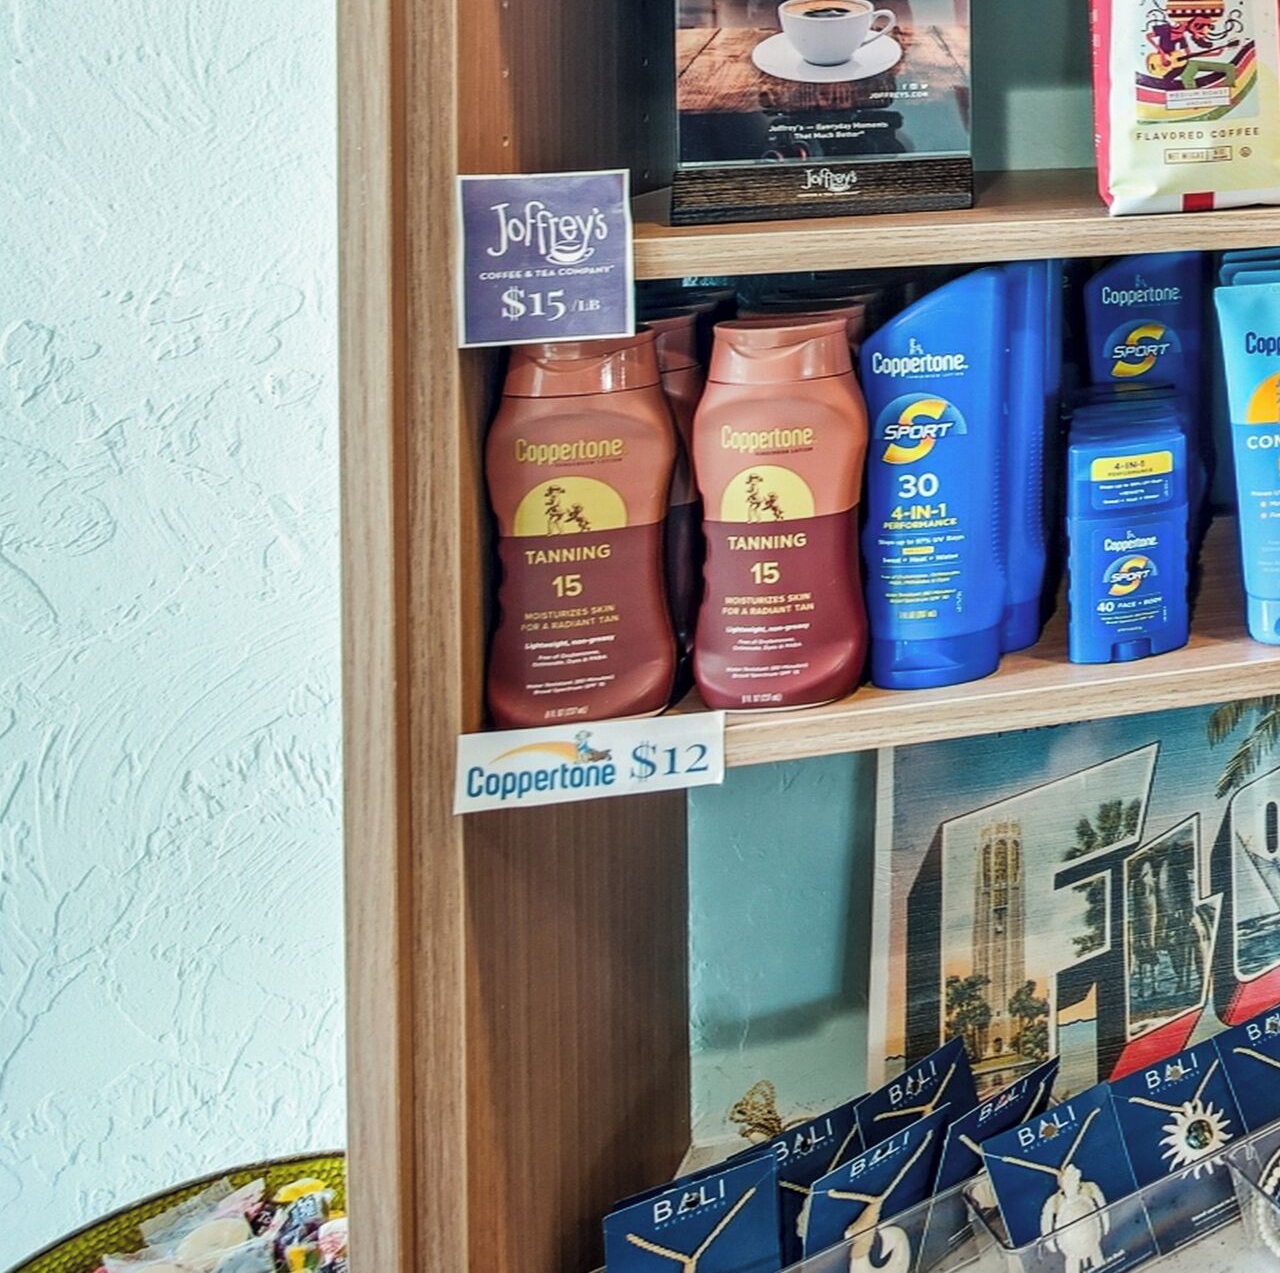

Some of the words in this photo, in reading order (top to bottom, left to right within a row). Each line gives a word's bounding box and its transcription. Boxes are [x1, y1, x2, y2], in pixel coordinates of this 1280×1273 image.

[1136, 130, 1205, 142] FLAVORED
[1209, 126, 1261, 139] COFFEE
[479, 269, 523, 280] COFFEE
[535, 268, 556, 277] TEA
[557, 265, 609, 276] COMPANY
[501, 285, 567, 322] $15
[1102, 286, 1180, 307] Coppertone
[1112, 342, 1171, 359] SPORT
[872, 350, 967, 378] Coppertone
[721, 425, 814, 454] Coppertone
[883, 420, 955, 443] SPORT
[515, 436, 624, 466] Coppertone
[897, 472, 940, 499] 30
[890, 503, 947, 521] 4-IN-1
[882, 517, 958, 530] PERFORMANCE
[727, 533, 807, 551] TANNING
[524, 544, 612, 565] TANNING
[750, 561, 781, 586] 15
[1110, 568, 1151, 584] SPORT
[550, 573, 583, 599] 15
[724, 594, 786, 606] MOISTURIZES
[787, 592, 812, 602] SKIN
[1097, 600, 1114, 613] 40
[523, 606, 589, 621] MOISTURIZES
[590, 604, 616, 614] SKIN
[722, 606, 740, 616] FOR
[750, 604, 792, 616] RADIANT
[794, 602, 816, 612] TAN
[520, 622, 541, 632] FOR
[551, 617, 596, 630] RADIANT
[598, 614, 620, 624] TAN
[466, 763, 617, 800] Coppertone
[629, 740, 710, 783] $12
